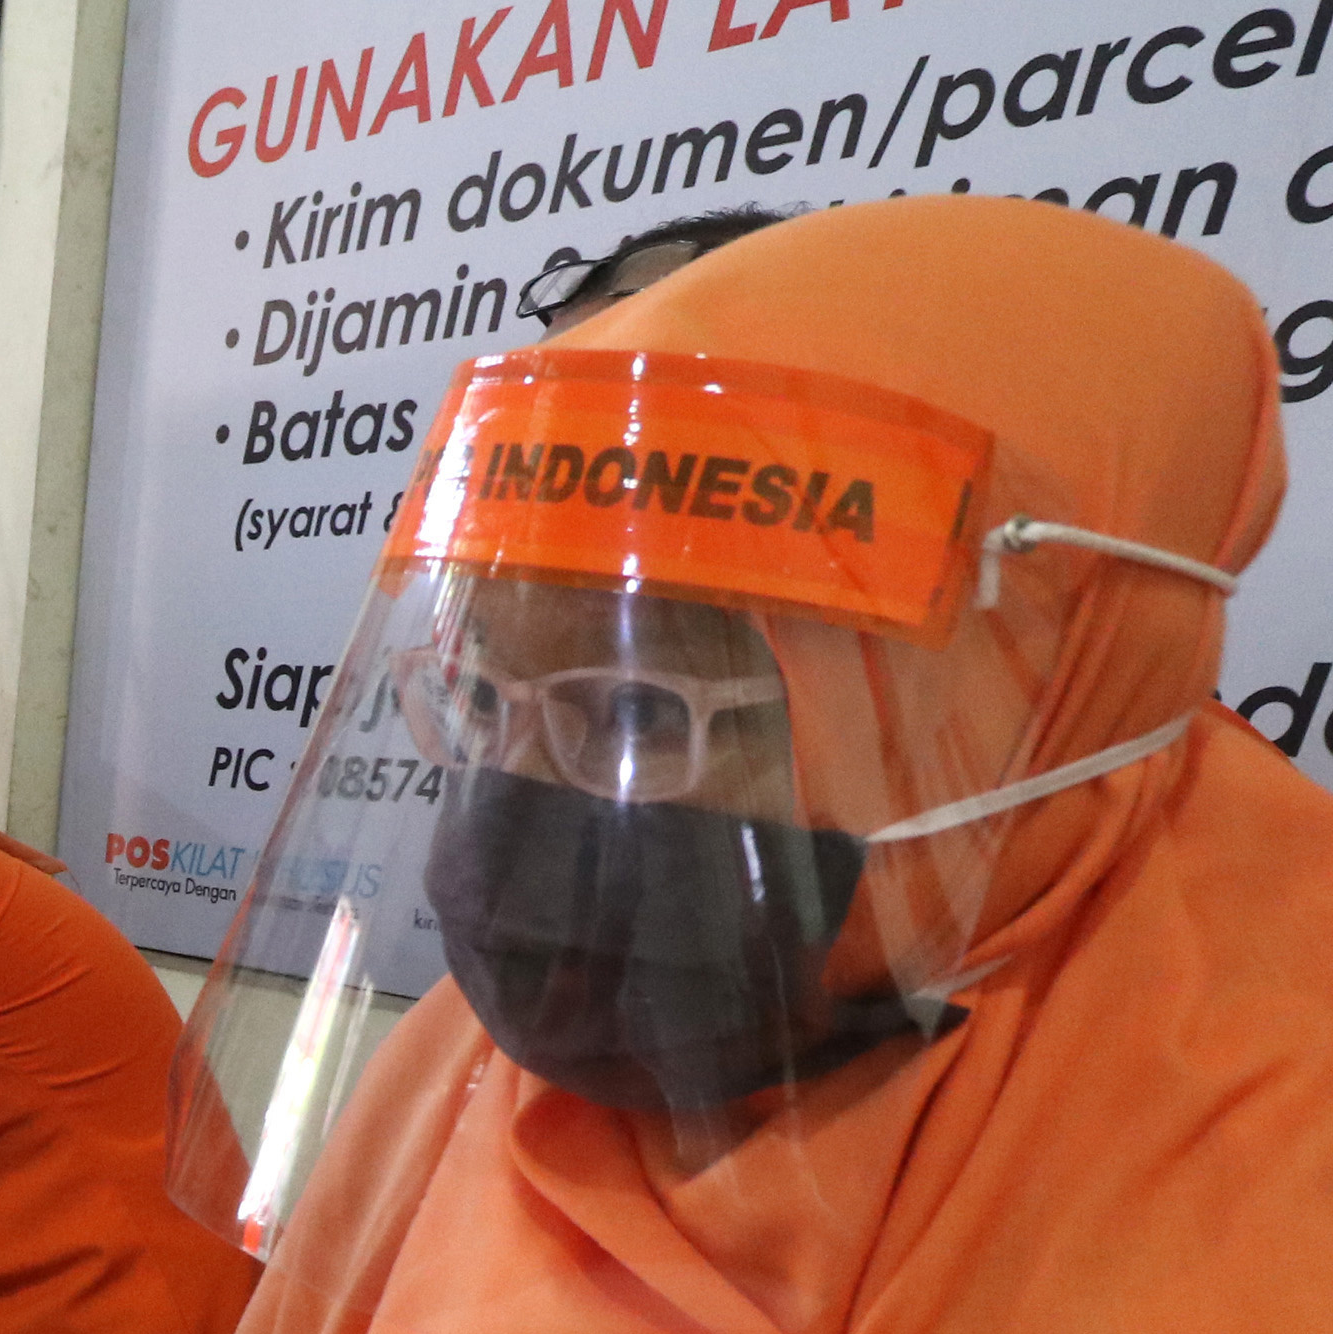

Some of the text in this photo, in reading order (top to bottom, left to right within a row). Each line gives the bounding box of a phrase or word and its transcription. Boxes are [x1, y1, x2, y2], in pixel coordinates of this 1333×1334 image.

[188, 0, 667, 178] GUNAKAN
[262, 181, 422, 269] Kirim
[252, 263, 508, 377] Dijamin
[242, 389, 418, 465] Batas
[234, 491, 372, 552] (syarat
[479, 442, 876, 543] INDONESIA
[207, 746, 275, 791] PIC
[113, 867, 237, 904] Terpercaya Dengan
